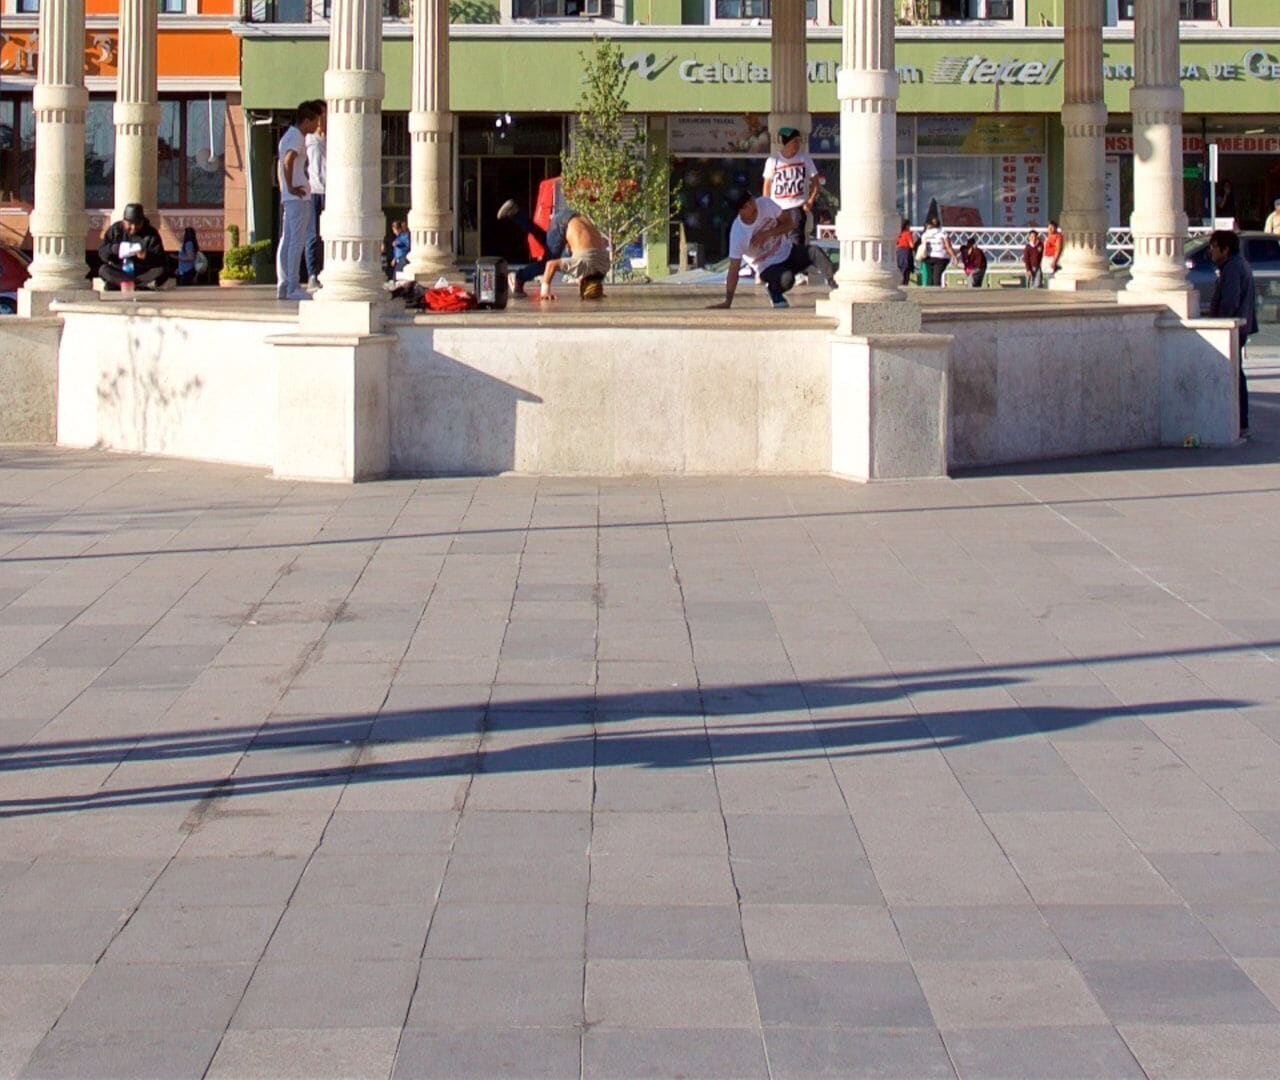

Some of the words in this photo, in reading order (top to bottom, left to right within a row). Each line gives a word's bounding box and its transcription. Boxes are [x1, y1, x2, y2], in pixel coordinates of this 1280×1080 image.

[679, 58, 771, 83] Celula
[960, 54, 1058, 84] telcel
[1208, 62, 1235, 78] DE
[775, 166, 806, 181] RUN
[774, 179, 805, 195] DMC
